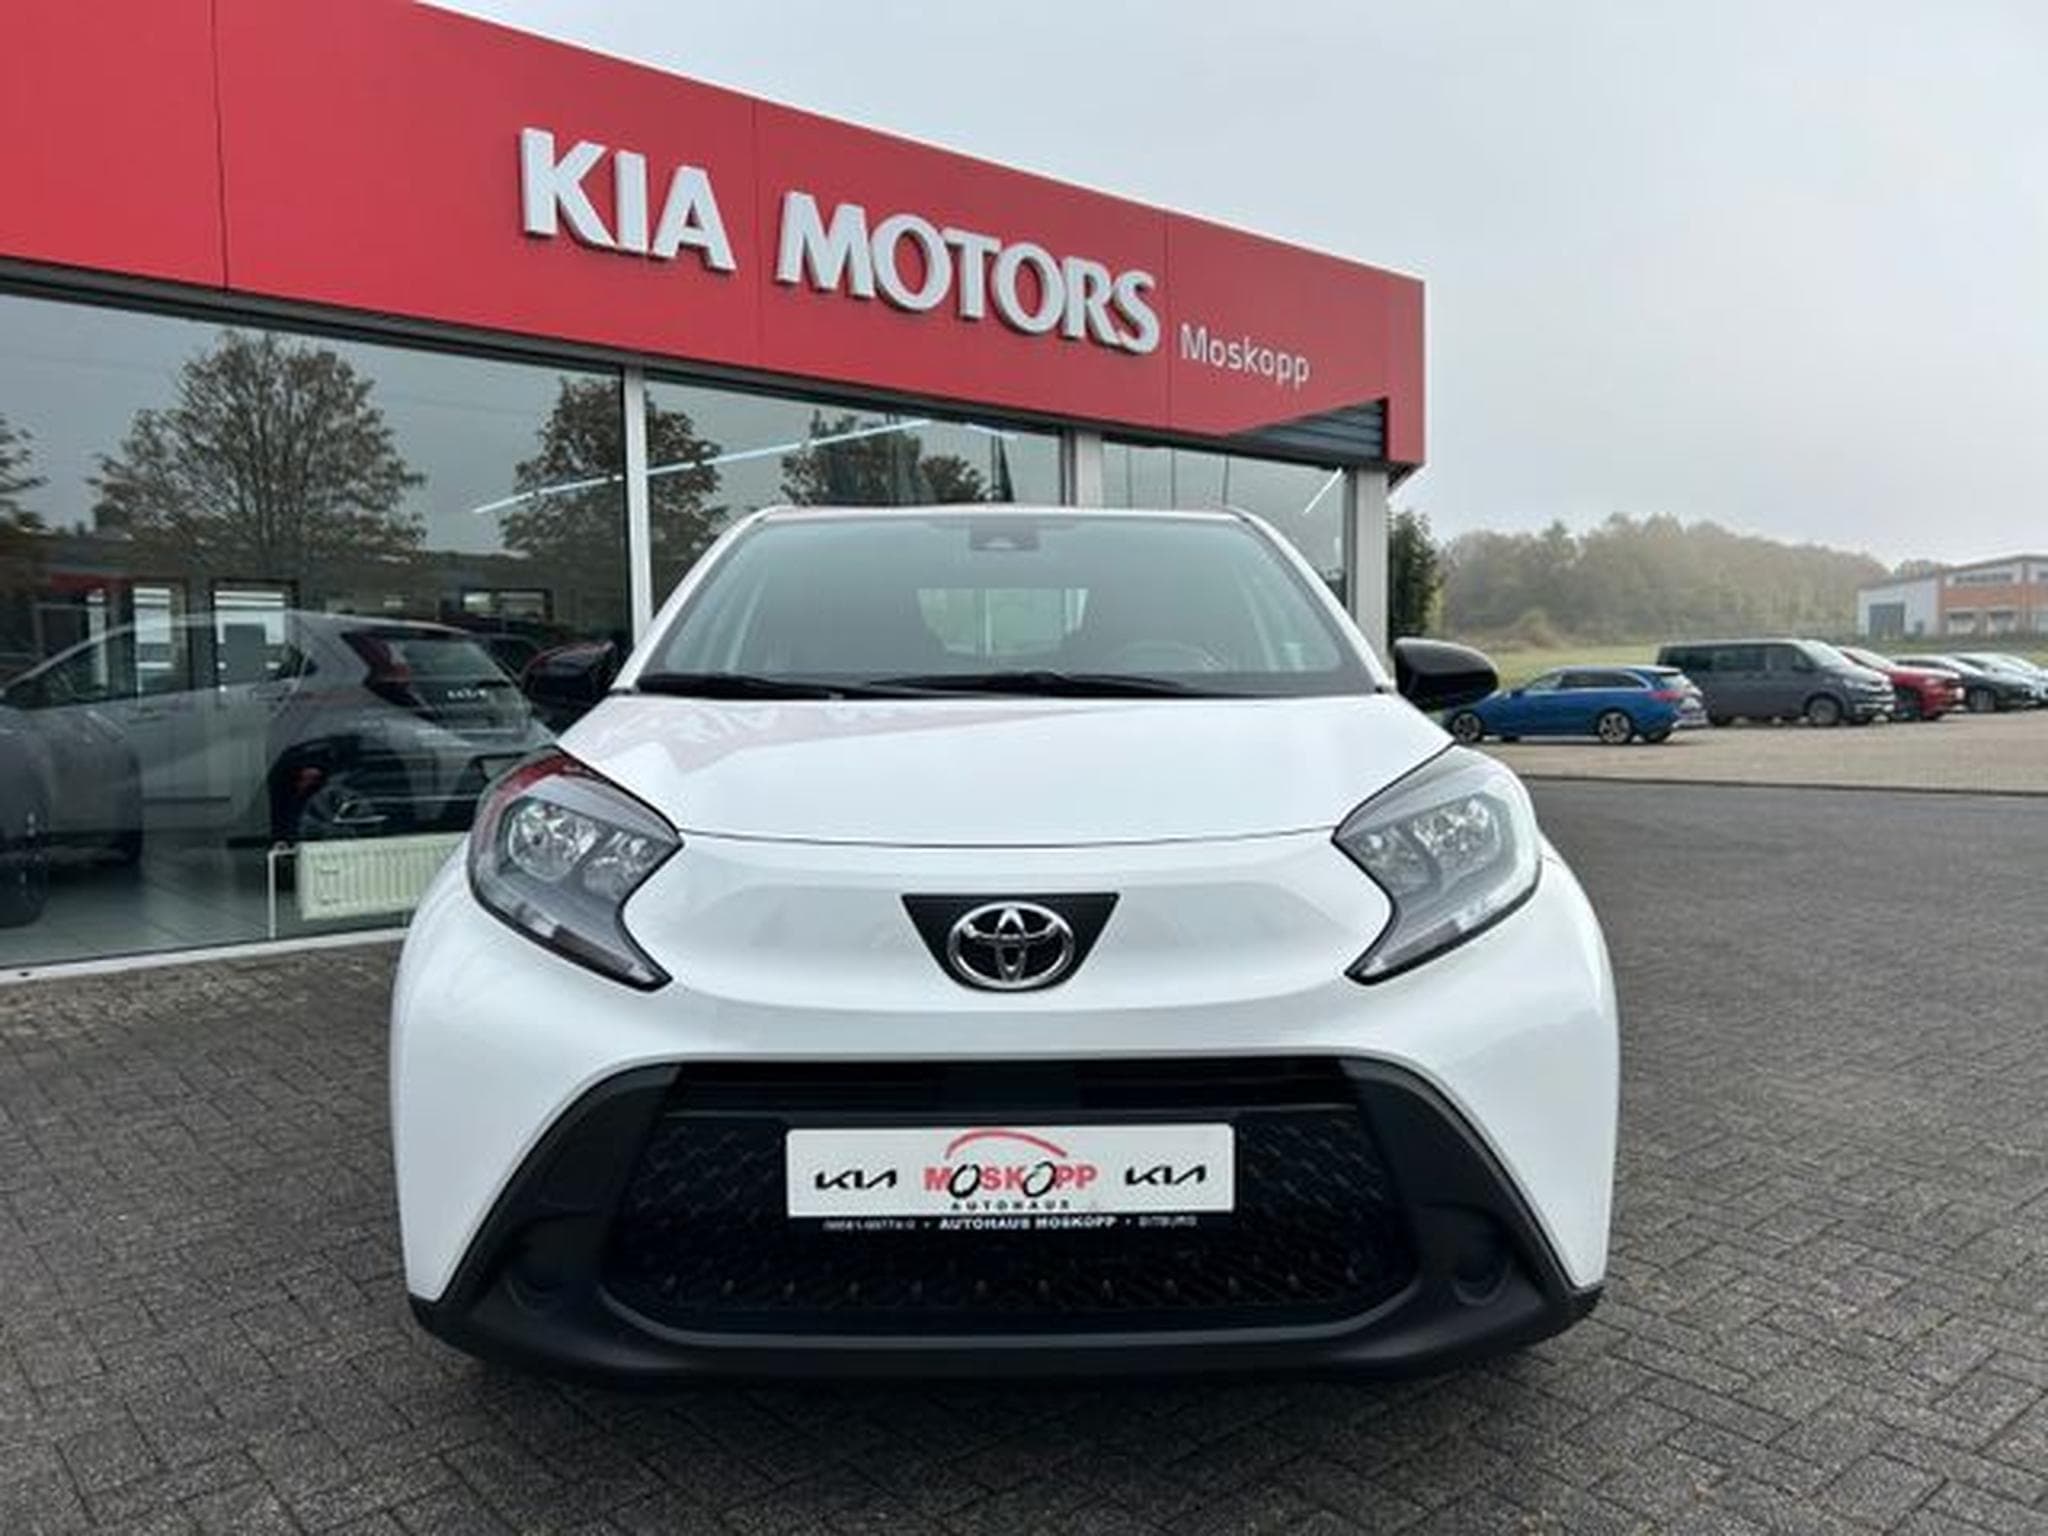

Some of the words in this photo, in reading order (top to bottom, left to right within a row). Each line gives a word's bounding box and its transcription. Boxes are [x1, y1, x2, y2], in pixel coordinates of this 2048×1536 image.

[519, 126, 734, 272] KIA
[775, 190, 1161, 355] MOTORS
[1180, 322, 1311, 390] Moskopp
[815, 1169, 897, 1189] KIA
[924, 1161, 1097, 1199] MOSKOPP
[1125, 1164, 1206, 1185] KIA
[952, 1200, 1070, 1210] AUTOHAUS
[939, 1217, 1030, 1230] AUTOHAUS
[1035, 1215, 1118, 1229] MOSKOPP
